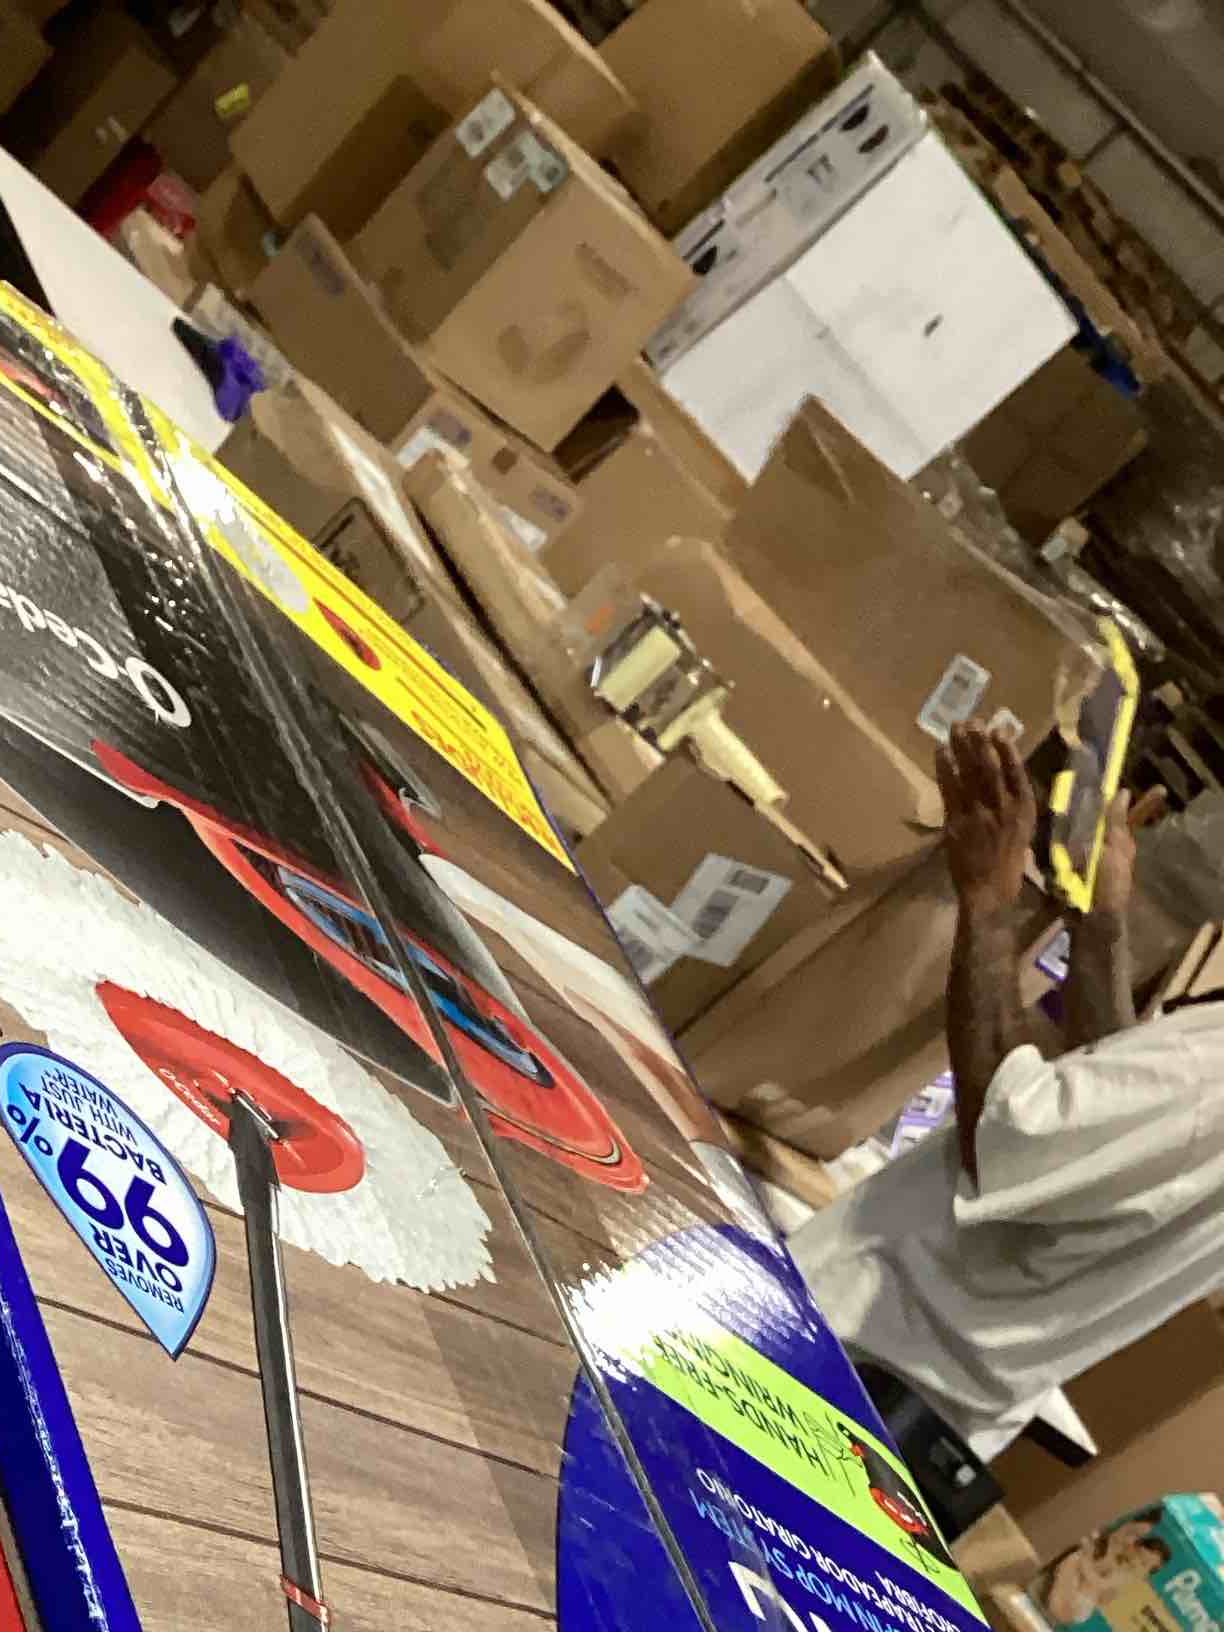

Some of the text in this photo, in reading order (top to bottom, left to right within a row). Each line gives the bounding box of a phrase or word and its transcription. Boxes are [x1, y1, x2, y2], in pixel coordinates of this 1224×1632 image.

[18, 1082, 167, 1185] BACTERIA
[40, 1075, 139, 1147] WITH JUST
[7, 1104, 189, 1267] 99%
[89, 1222, 183, 1293] OVER
[105, 1257, 185, 1314] REMOVES
[795, 1563, 858, 1624] MOP
